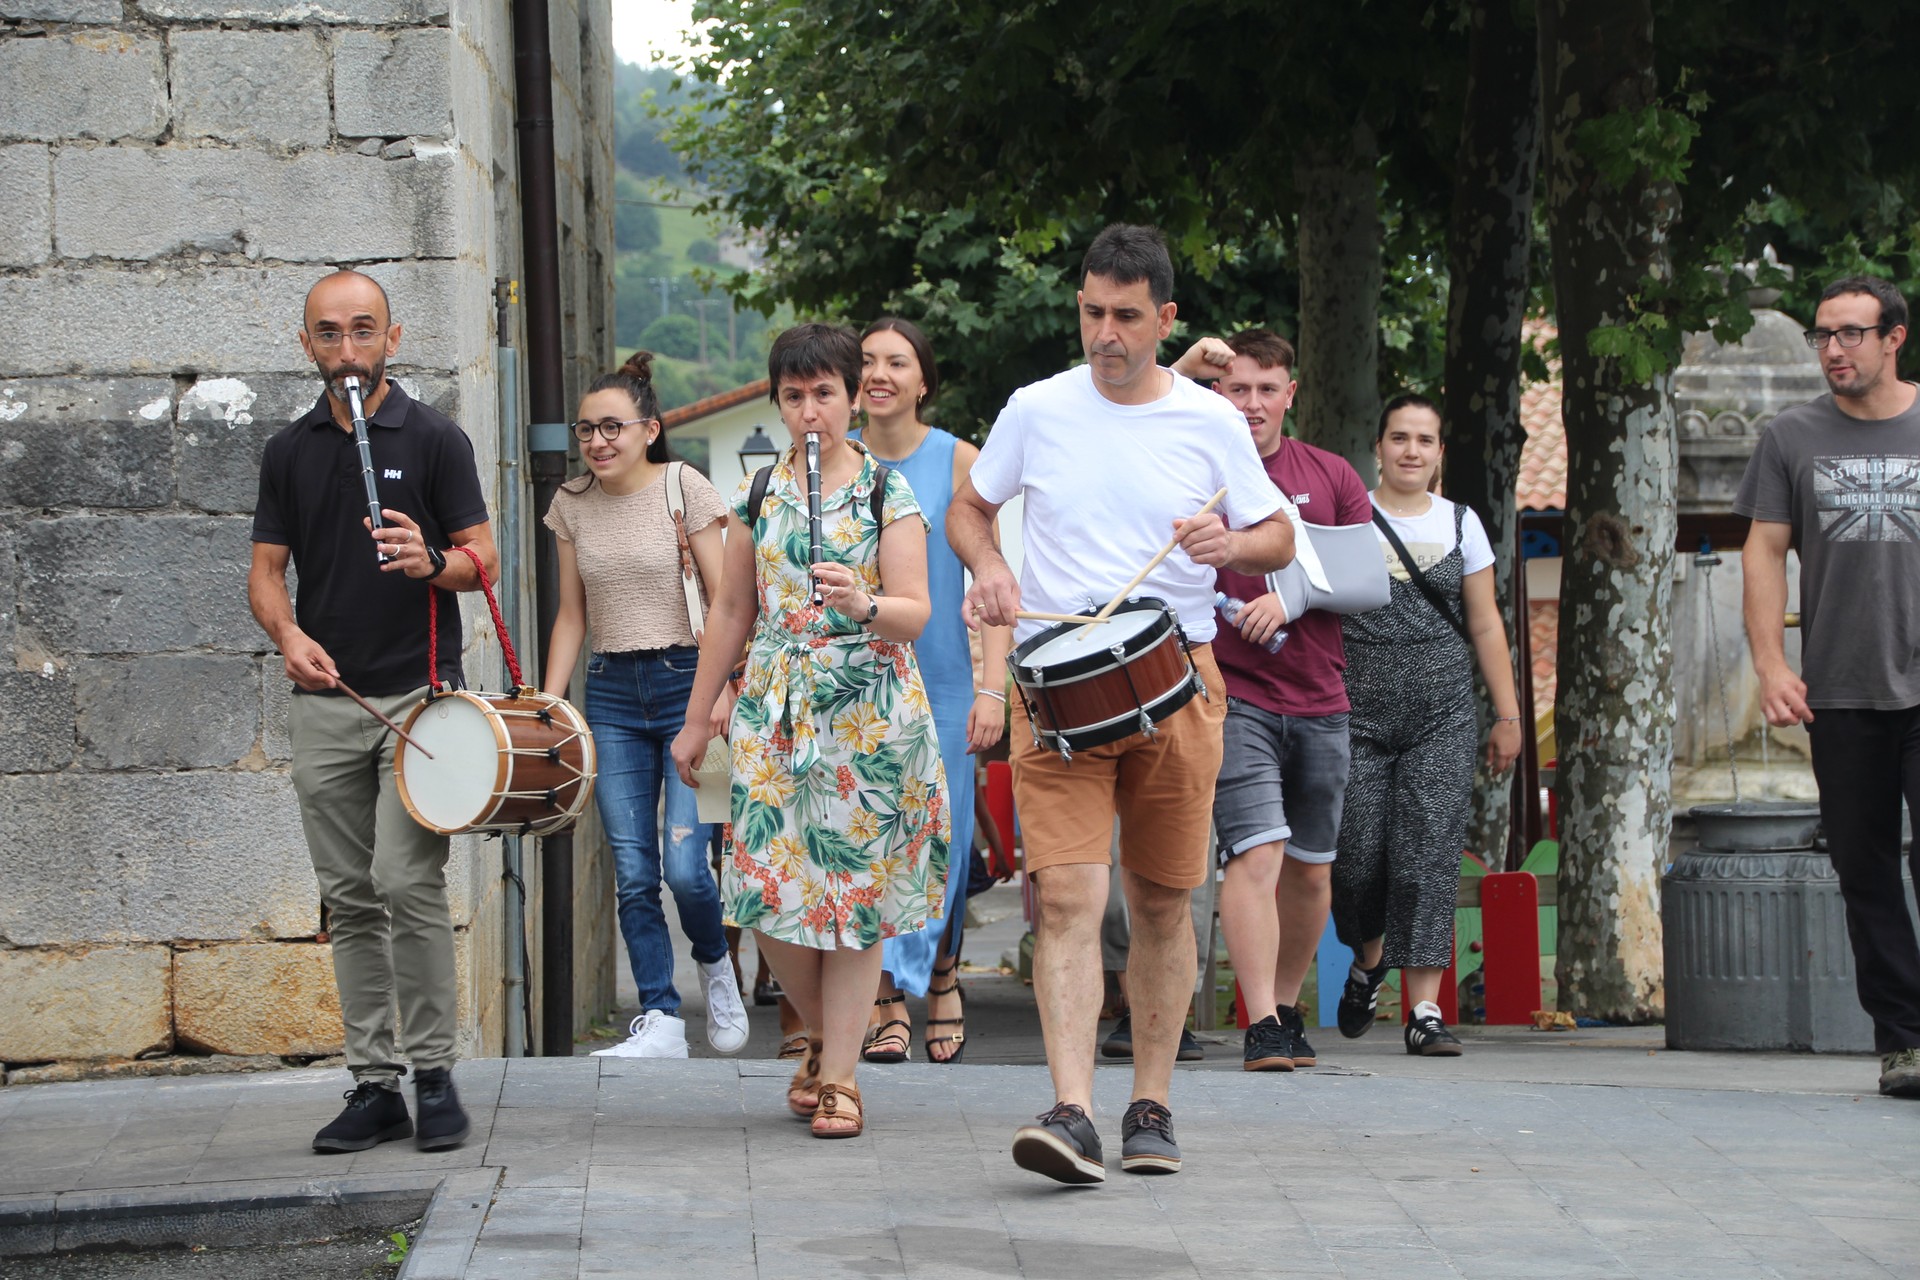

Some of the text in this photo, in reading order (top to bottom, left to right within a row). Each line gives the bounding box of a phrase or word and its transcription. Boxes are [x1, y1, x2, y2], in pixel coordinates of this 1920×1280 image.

[384, 469, 402, 479] HH
[1834, 493, 1917, 505] ORIGINAL URBAN
